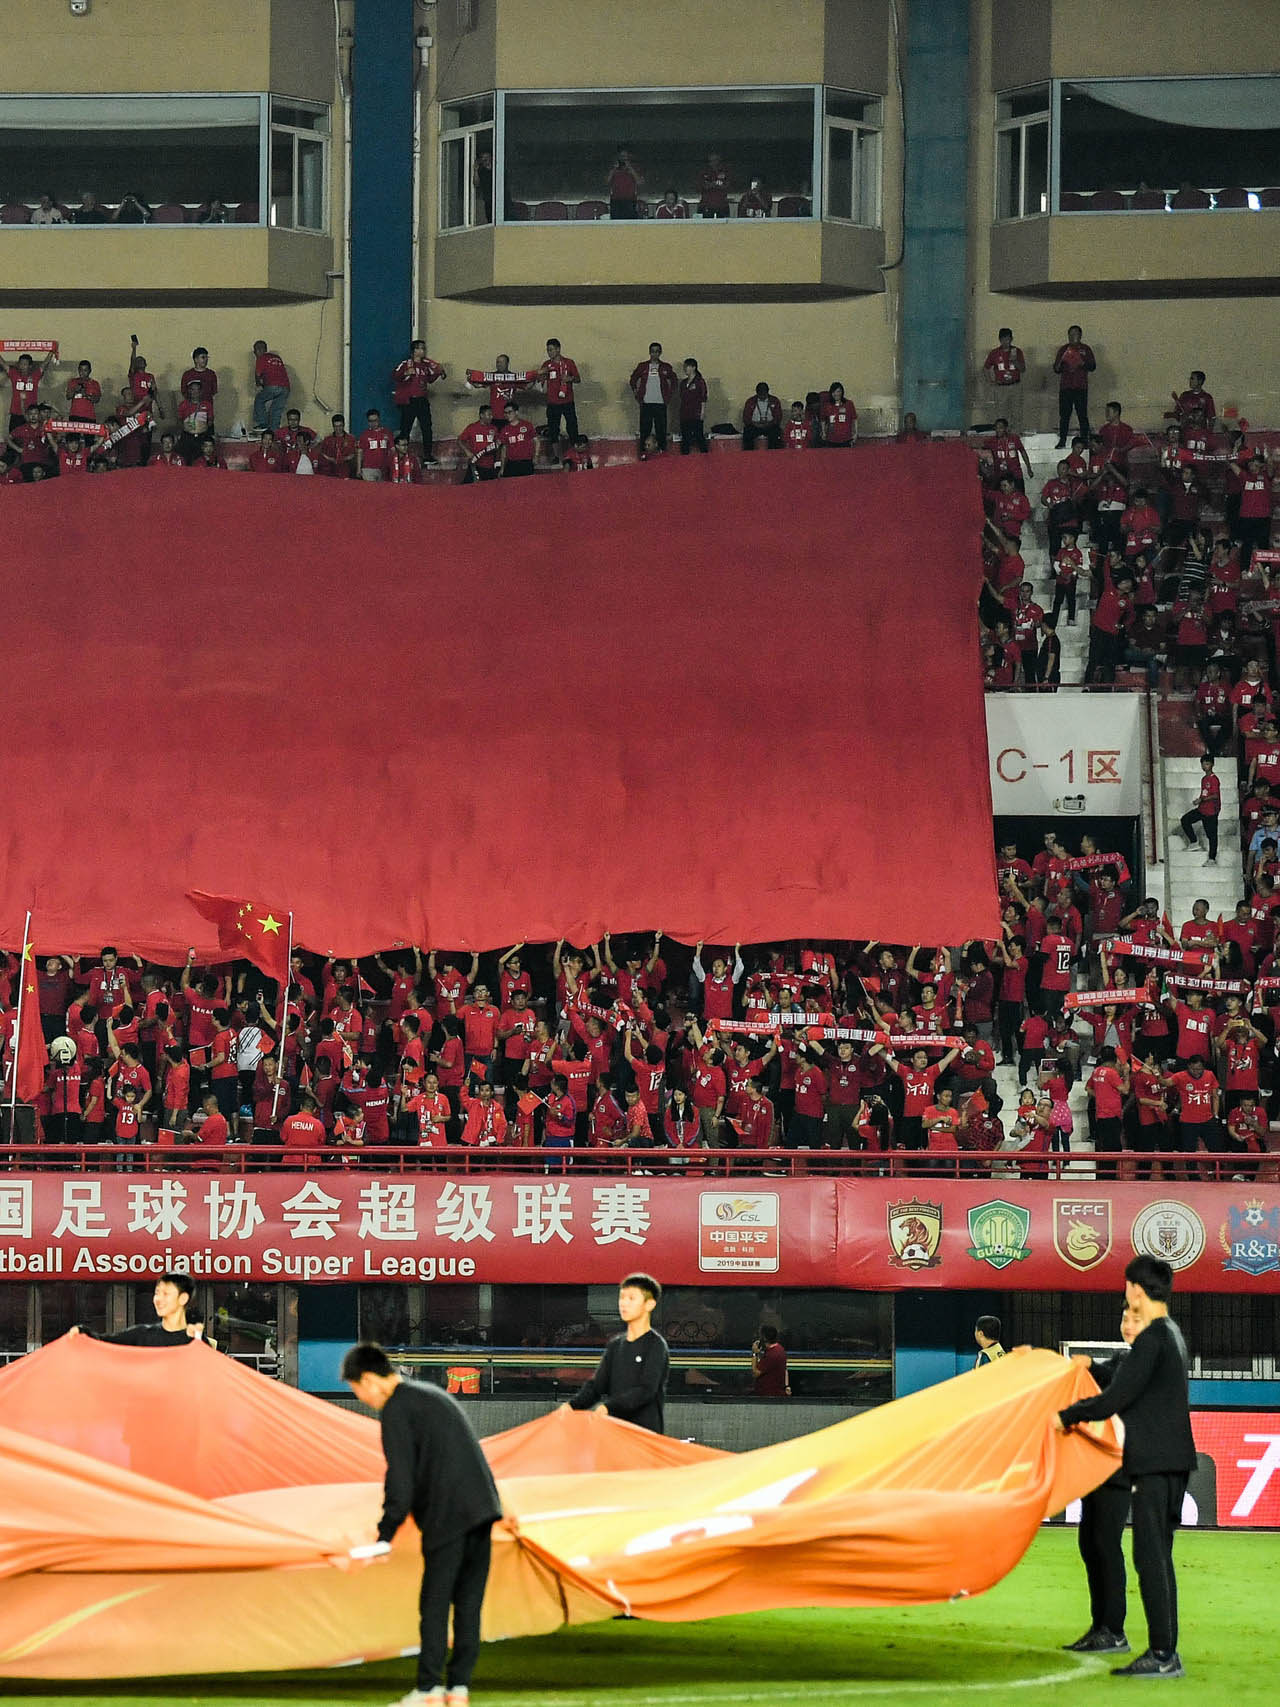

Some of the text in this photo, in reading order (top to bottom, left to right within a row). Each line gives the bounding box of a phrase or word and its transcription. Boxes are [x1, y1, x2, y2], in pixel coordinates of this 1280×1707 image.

[996, 747, 1122, 784] C-1区
[1131, 944, 1184, 962] 河南建业
[1057, 952, 1070, 970] 12
[769, 1012, 819, 1025] 河南建业
[824, 1027, 877, 1042] 河南建业
[649, 1072, 663, 1091] 12
[907, 1082, 930, 1096] 河南
[365, 1099, 387, 1108] HENAN
[121, 1112, 134, 1125] 13
[291, 1121, 314, 1132] HENAN
[740, 1213, 761, 1222] CSL
[1060, 1204, 1105, 1217] CFFC
[709, 1230, 769, 1243] 中国平安
[1234, 1239, 1279, 1259] R&F
[72, 1247, 252, 1274] Association
[261, 1248, 354, 1281] Super
[364, 1249, 476, 1281] League
